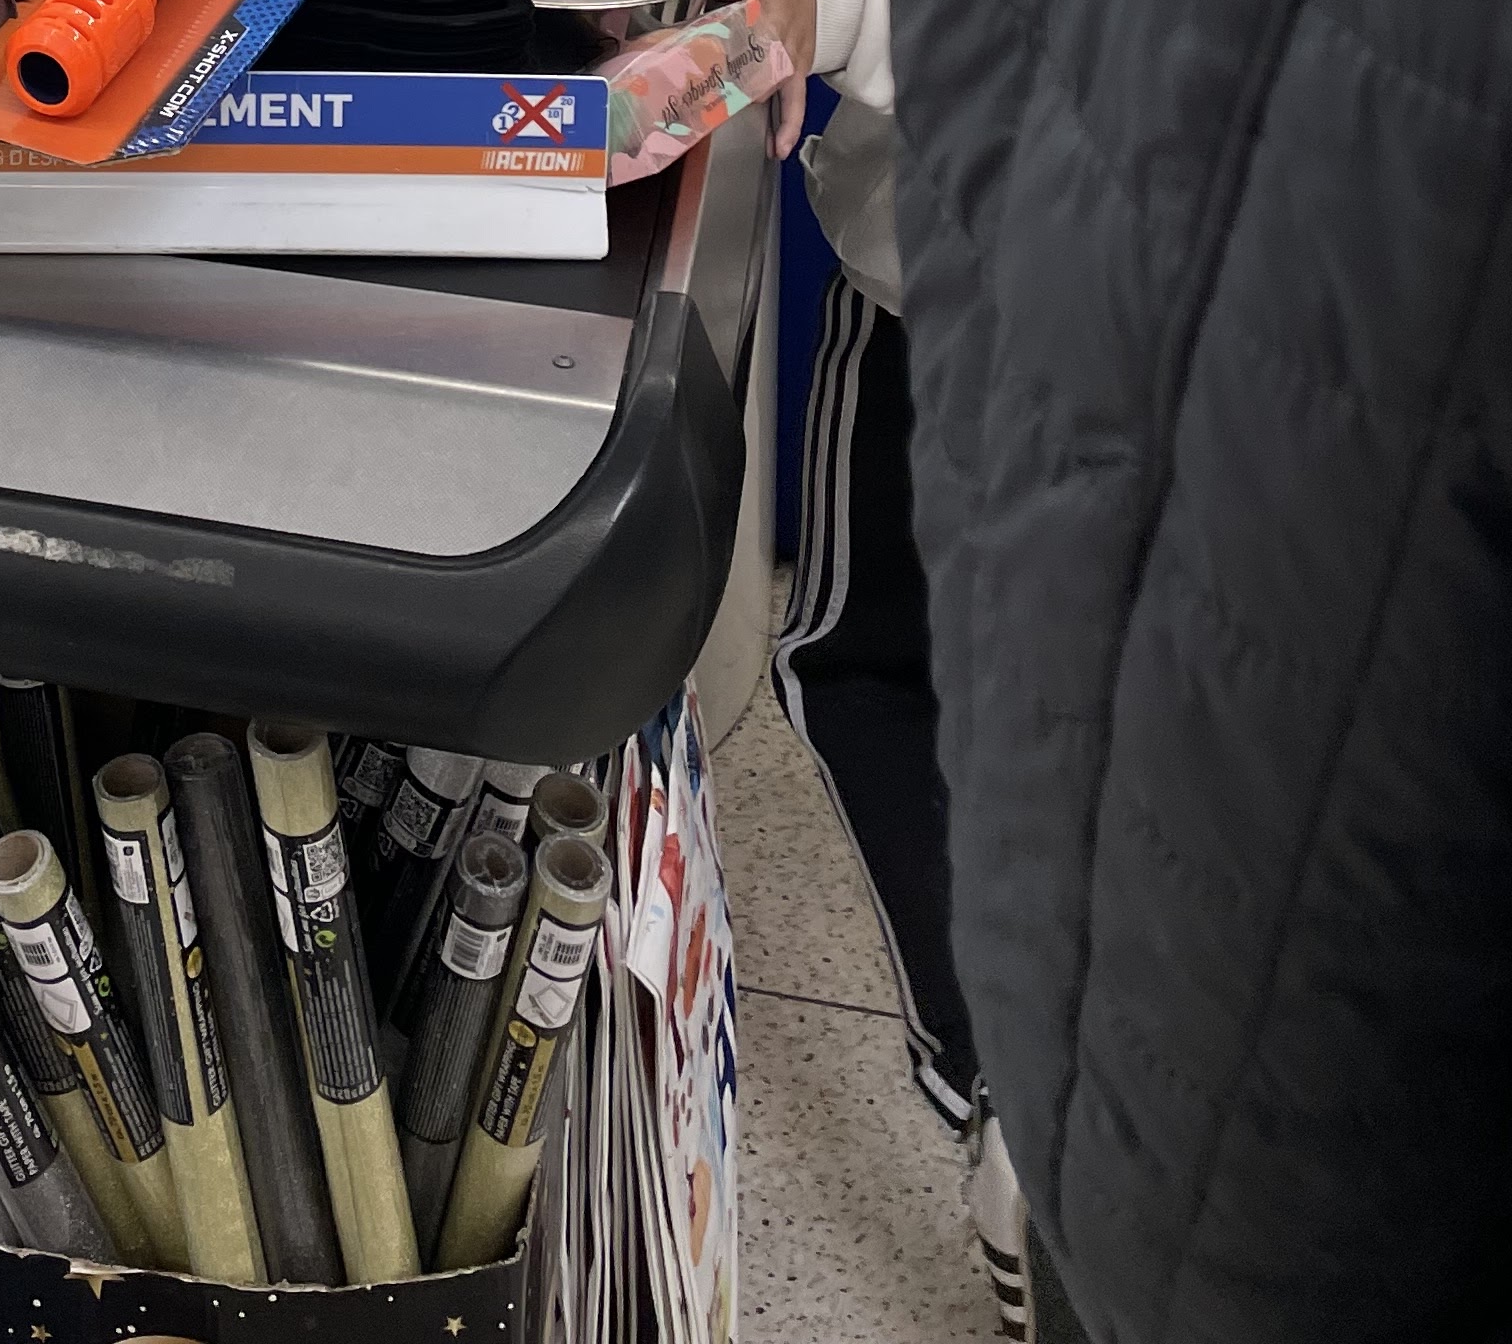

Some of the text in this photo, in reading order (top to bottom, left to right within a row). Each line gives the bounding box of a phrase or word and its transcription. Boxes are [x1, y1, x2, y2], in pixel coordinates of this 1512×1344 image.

[158, 29, 240, 118] X-SHOT.COM
[560, 97, 574, 106] 20
[498, 115, 508, 131] 1
[496, 150, 572, 172] ACTION
[7, 1120, 25, 1148] WITH
[3, 1146, 26, 1182] GLITTER
[19, 1146, 39, 1176] PAPER
